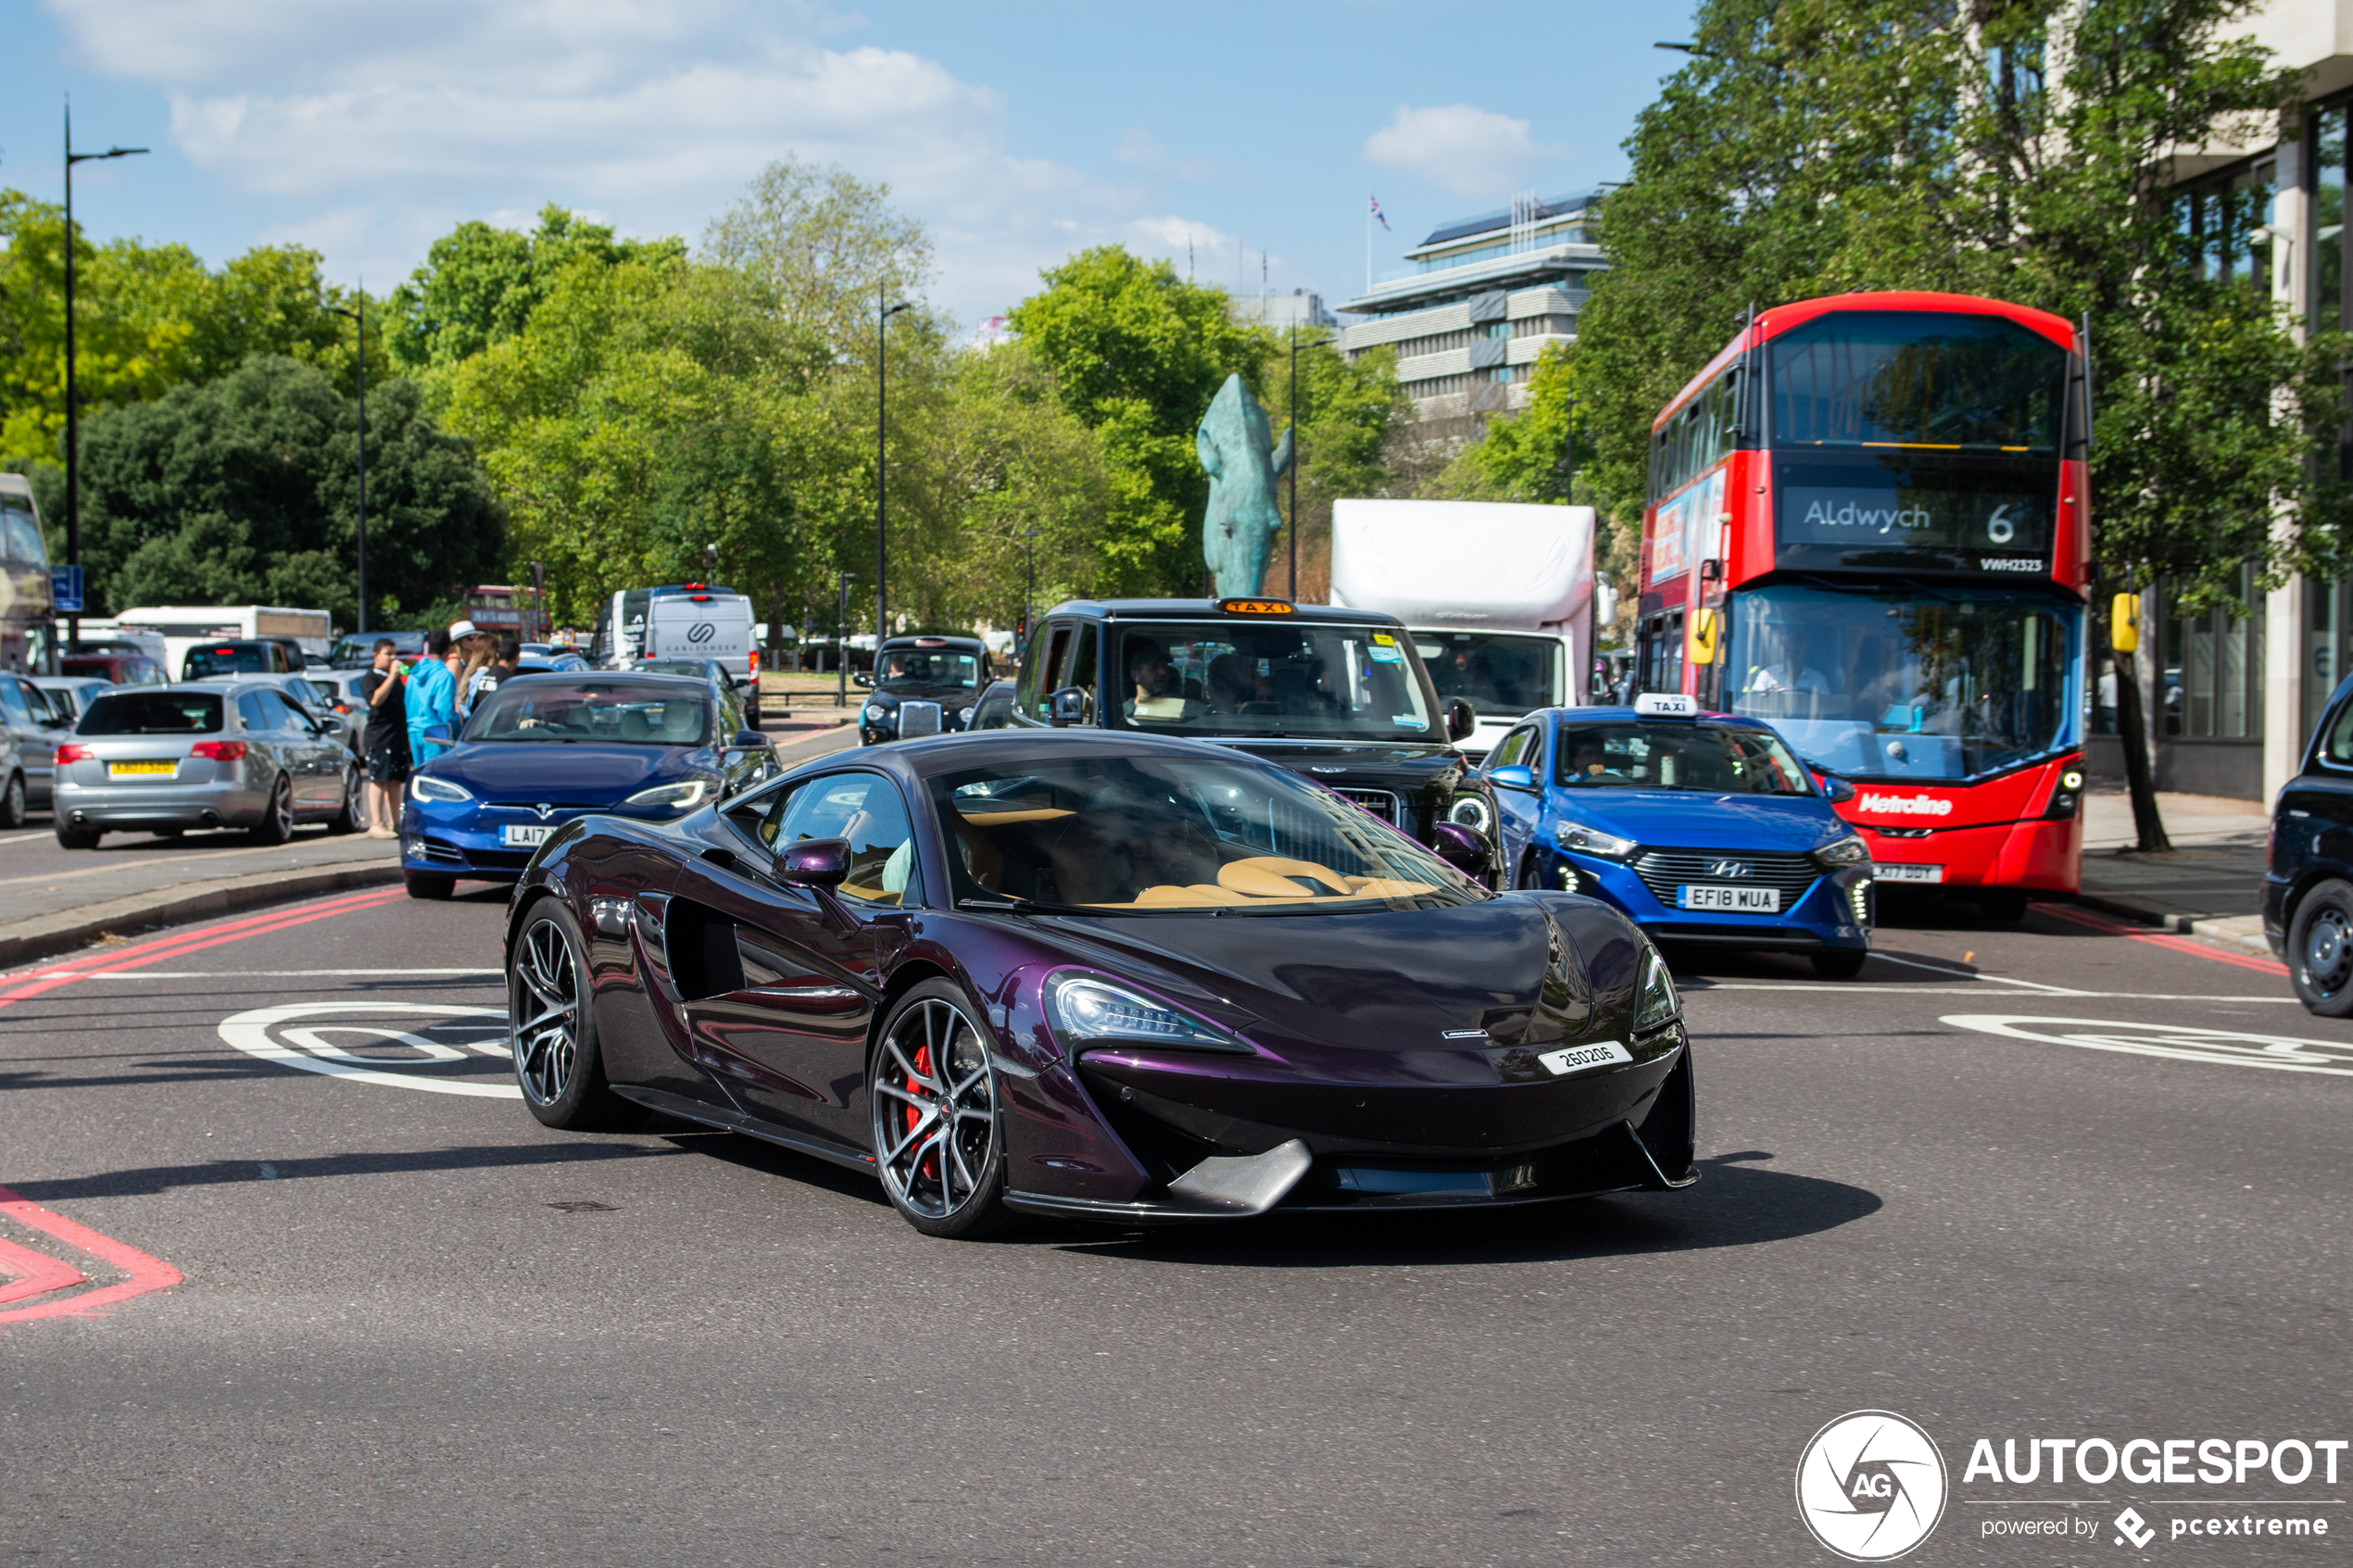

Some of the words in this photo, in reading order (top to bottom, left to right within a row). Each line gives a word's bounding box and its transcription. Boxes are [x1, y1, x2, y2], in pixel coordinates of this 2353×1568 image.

[1804, 500, 1931, 534] Aldwych
[1987, 503, 2014, 544] 6
[1981, 558, 2043, 571] VWH2323
[1231, 603, 1285, 612] TAXI
[666, 644, 737, 652] CABLESHEER
[1654, 702, 1686, 712] TAXI
[1858, 793, 1953, 816] Metroline
[511, 828, 547, 843] LA17
[1692, 889, 1732, 907] EF18
[1738, 891, 1771, 908] WUA
[1559, 1047, 1615, 1067] 260206
